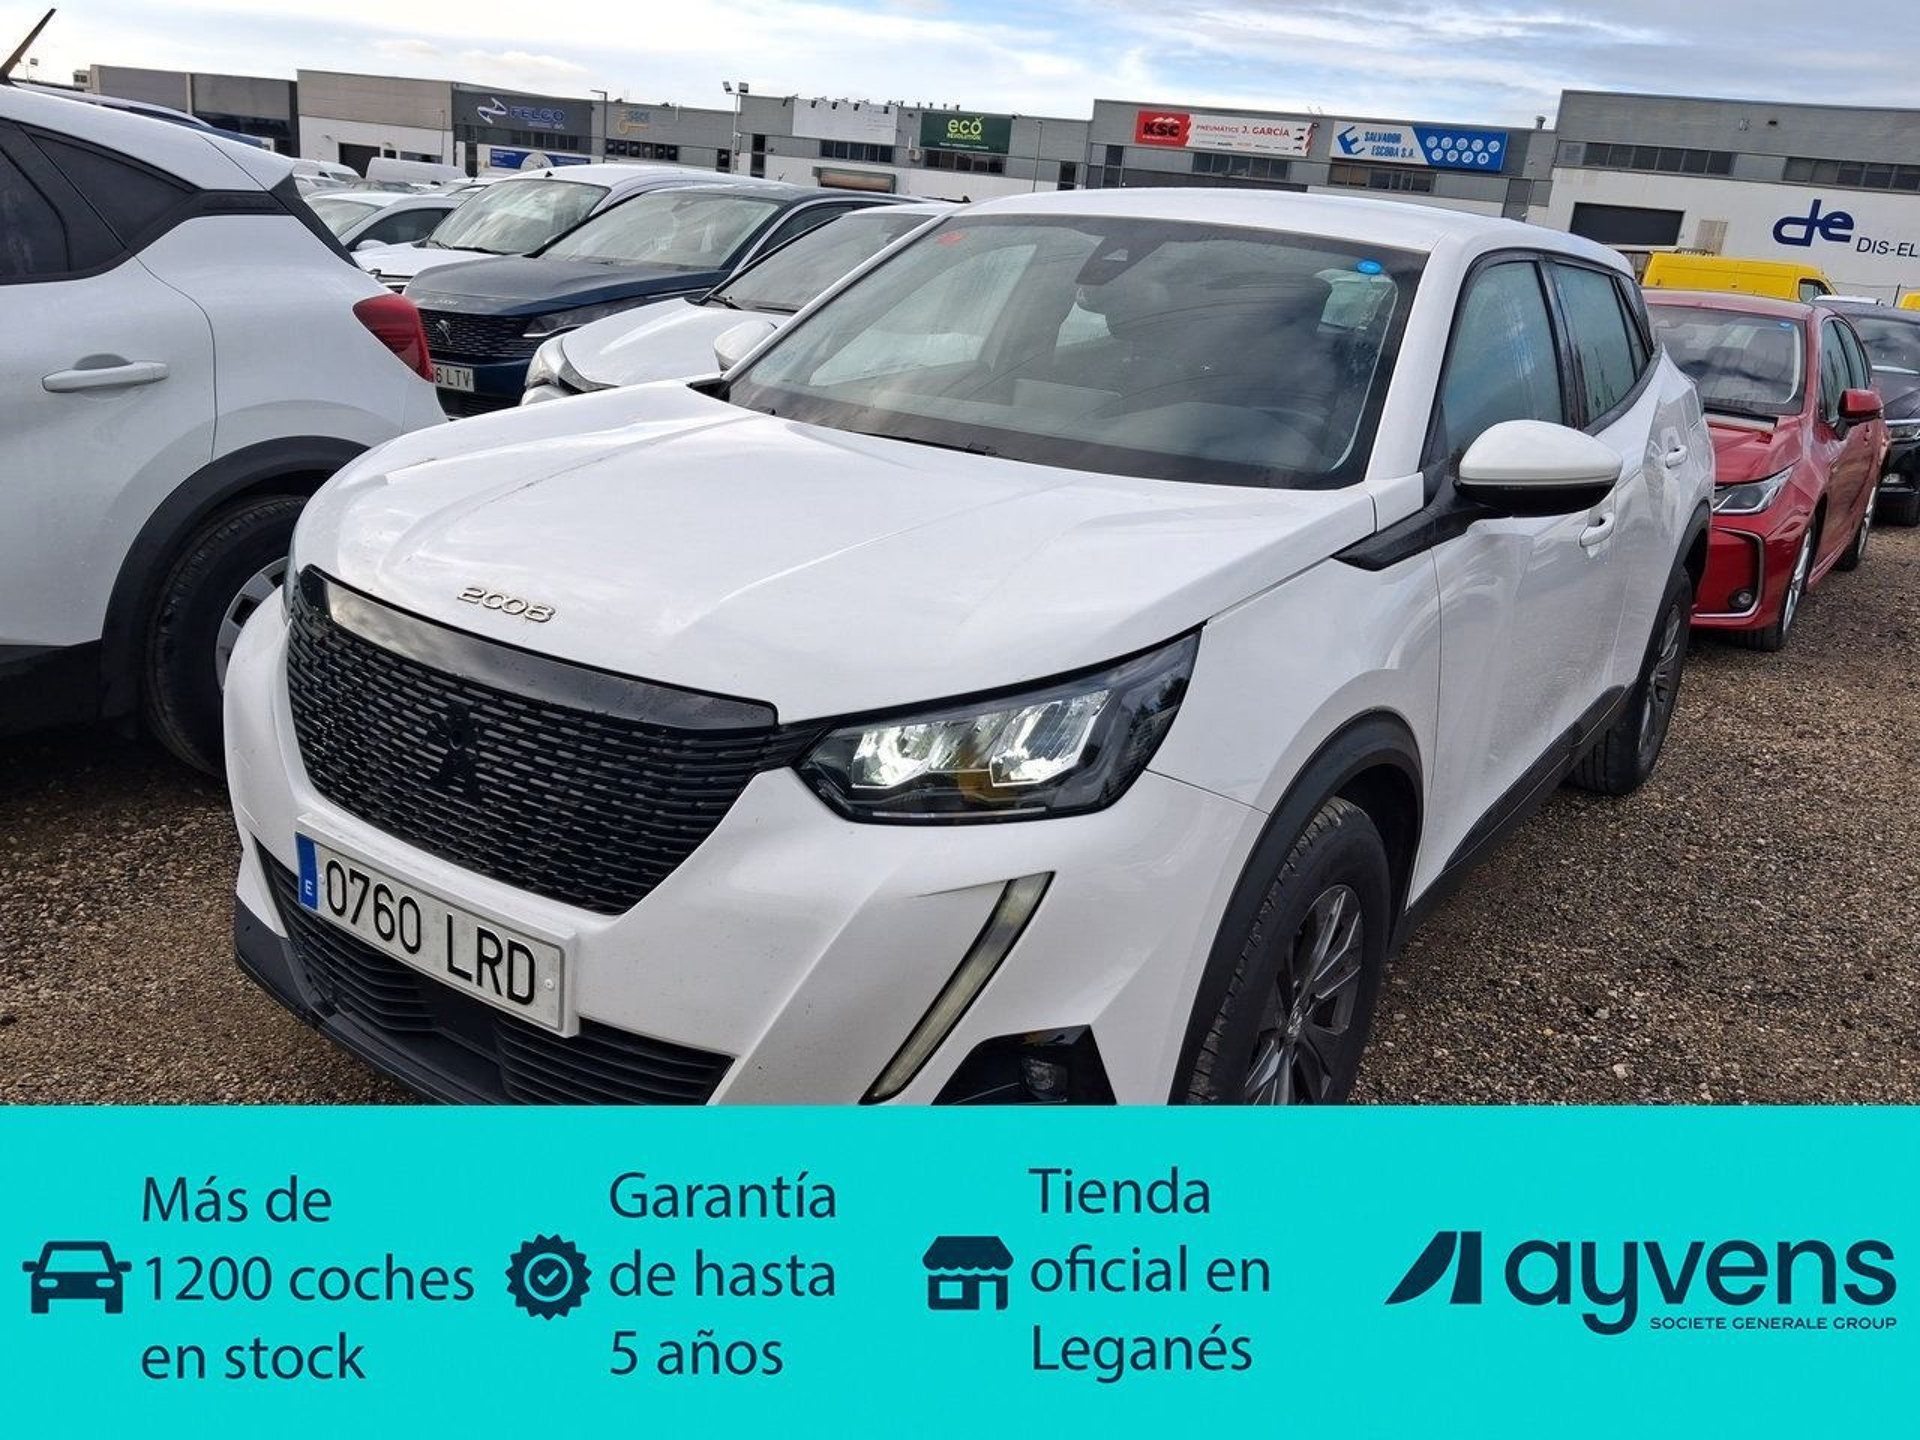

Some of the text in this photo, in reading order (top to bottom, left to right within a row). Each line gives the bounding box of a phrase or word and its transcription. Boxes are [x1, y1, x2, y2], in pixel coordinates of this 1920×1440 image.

[509, 106, 565, 122] FELCO
[1143, 121, 1180, 137] KSC
[1241, 125, 1249, 134] J.
[1364, 131, 1402, 144] SALVADOR
[446, 368, 472, 388] LTV
[457, 587, 556, 623] 2008
[305, 878, 314, 897] E
[326, 859, 536, 1006] 0760 LRD
